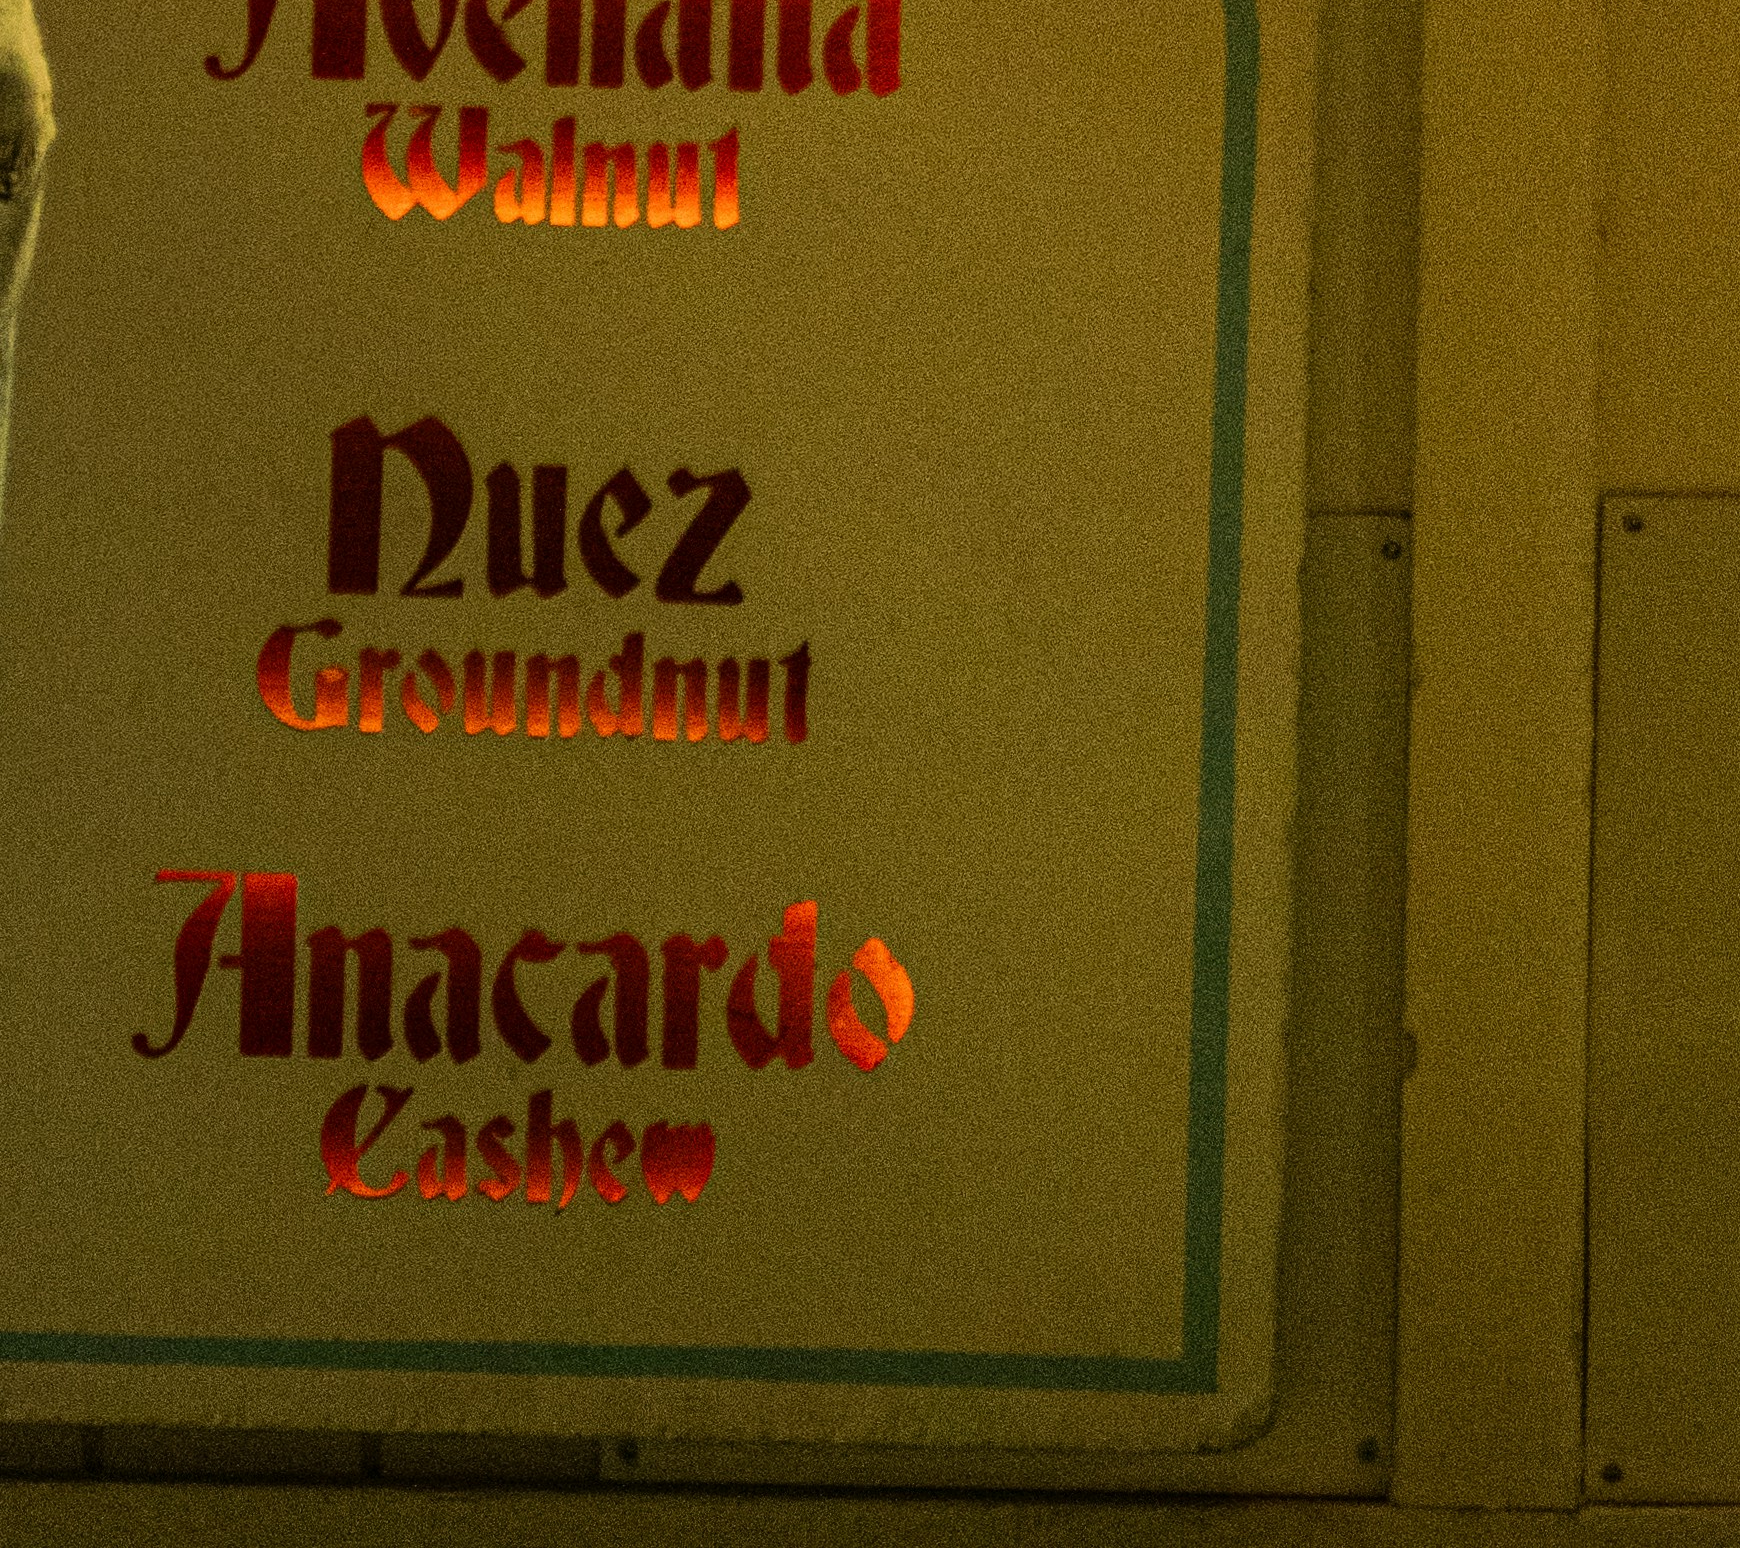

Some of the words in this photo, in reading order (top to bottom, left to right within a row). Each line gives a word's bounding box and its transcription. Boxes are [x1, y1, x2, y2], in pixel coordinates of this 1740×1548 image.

[360, 101, 742, 231] Walnut
[325, 413, 753, 606] Nuez
[255, 617, 814, 745] Groundnut
[130, 868, 916, 1073] Anacardo
[320, 1082, 718, 1212] Cashew
